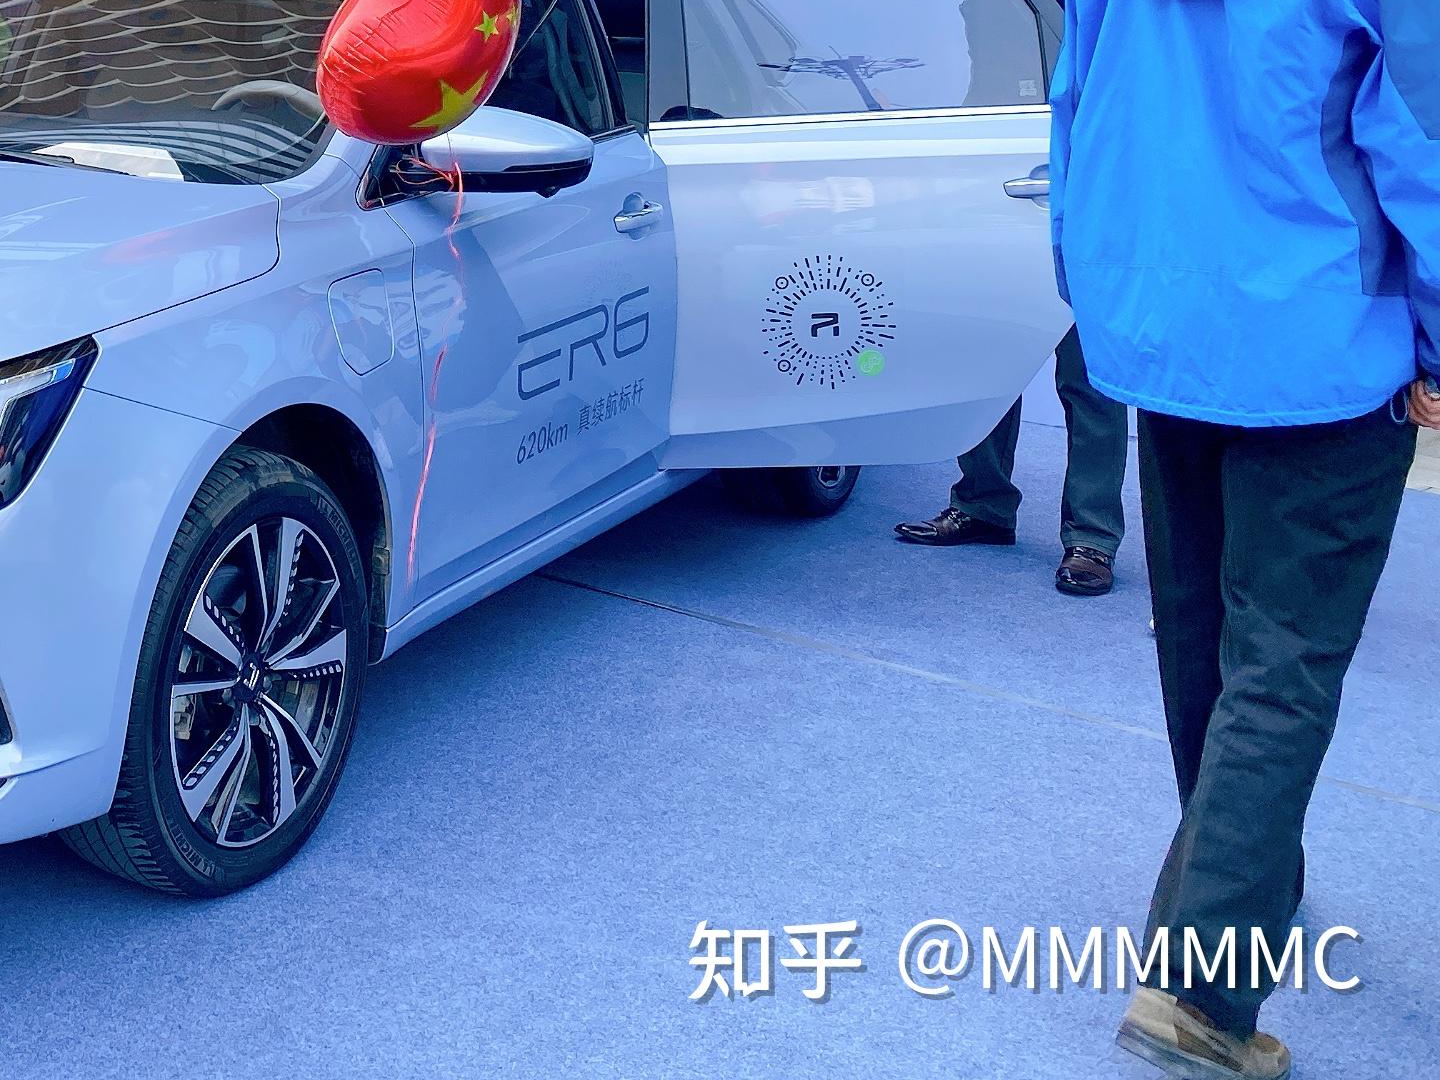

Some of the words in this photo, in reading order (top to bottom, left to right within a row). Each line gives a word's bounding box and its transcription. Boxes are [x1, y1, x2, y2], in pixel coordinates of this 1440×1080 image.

[517, 286, 650, 402] ER6
[516, 421, 569, 465] 620km
[576, 377, 646, 436] 真续航标杆
